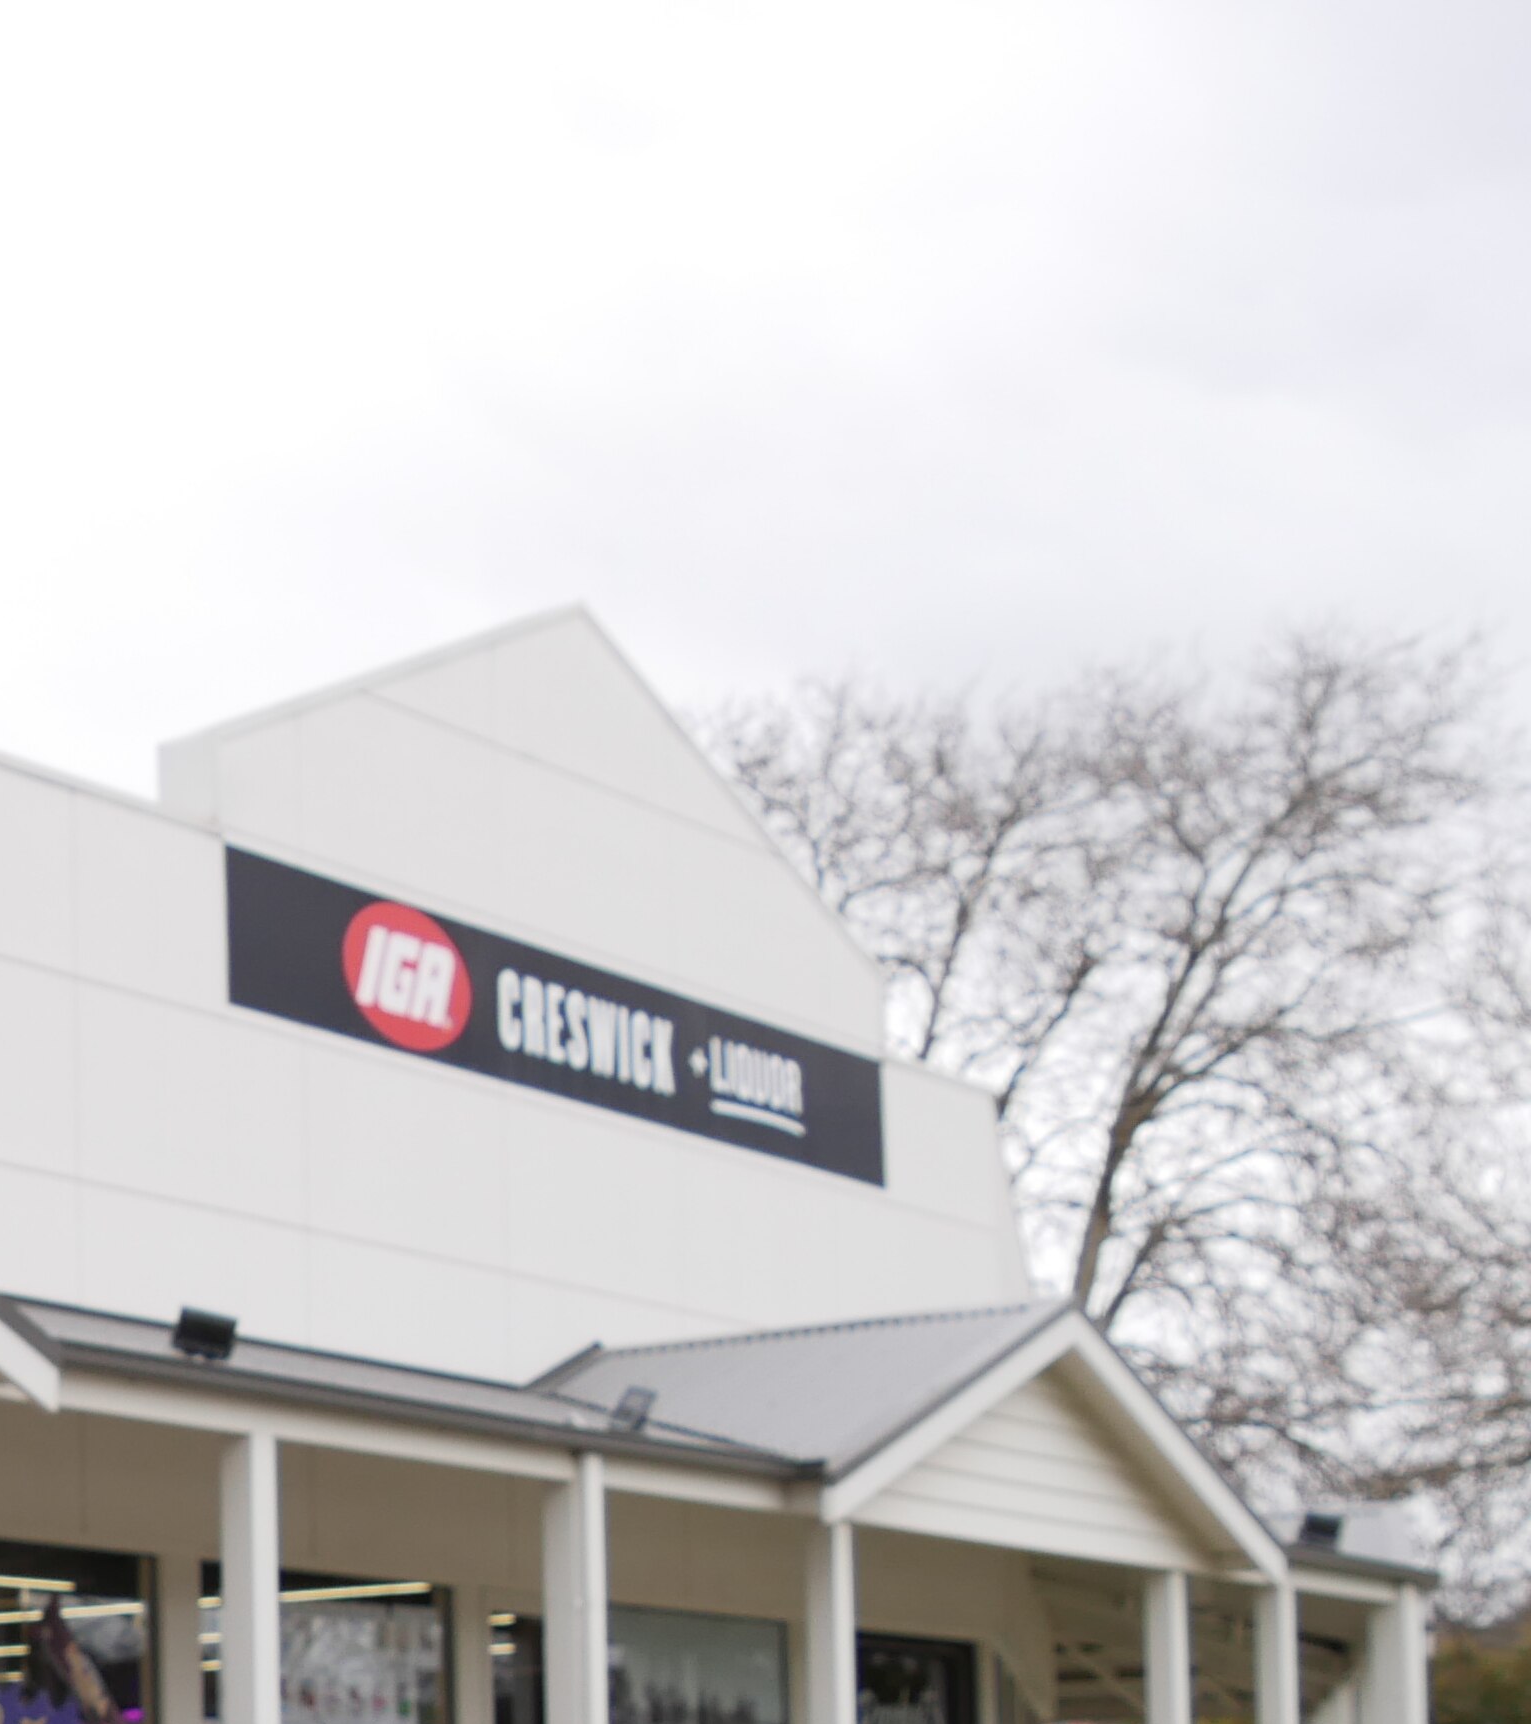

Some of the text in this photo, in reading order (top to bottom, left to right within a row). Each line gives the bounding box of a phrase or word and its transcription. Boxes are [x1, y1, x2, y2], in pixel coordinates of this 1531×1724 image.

[354, 923, 457, 1031] IGA
[496, 967, 677, 1098] CRESWICK
[708, 1034, 804, 1119] LIQUOR
